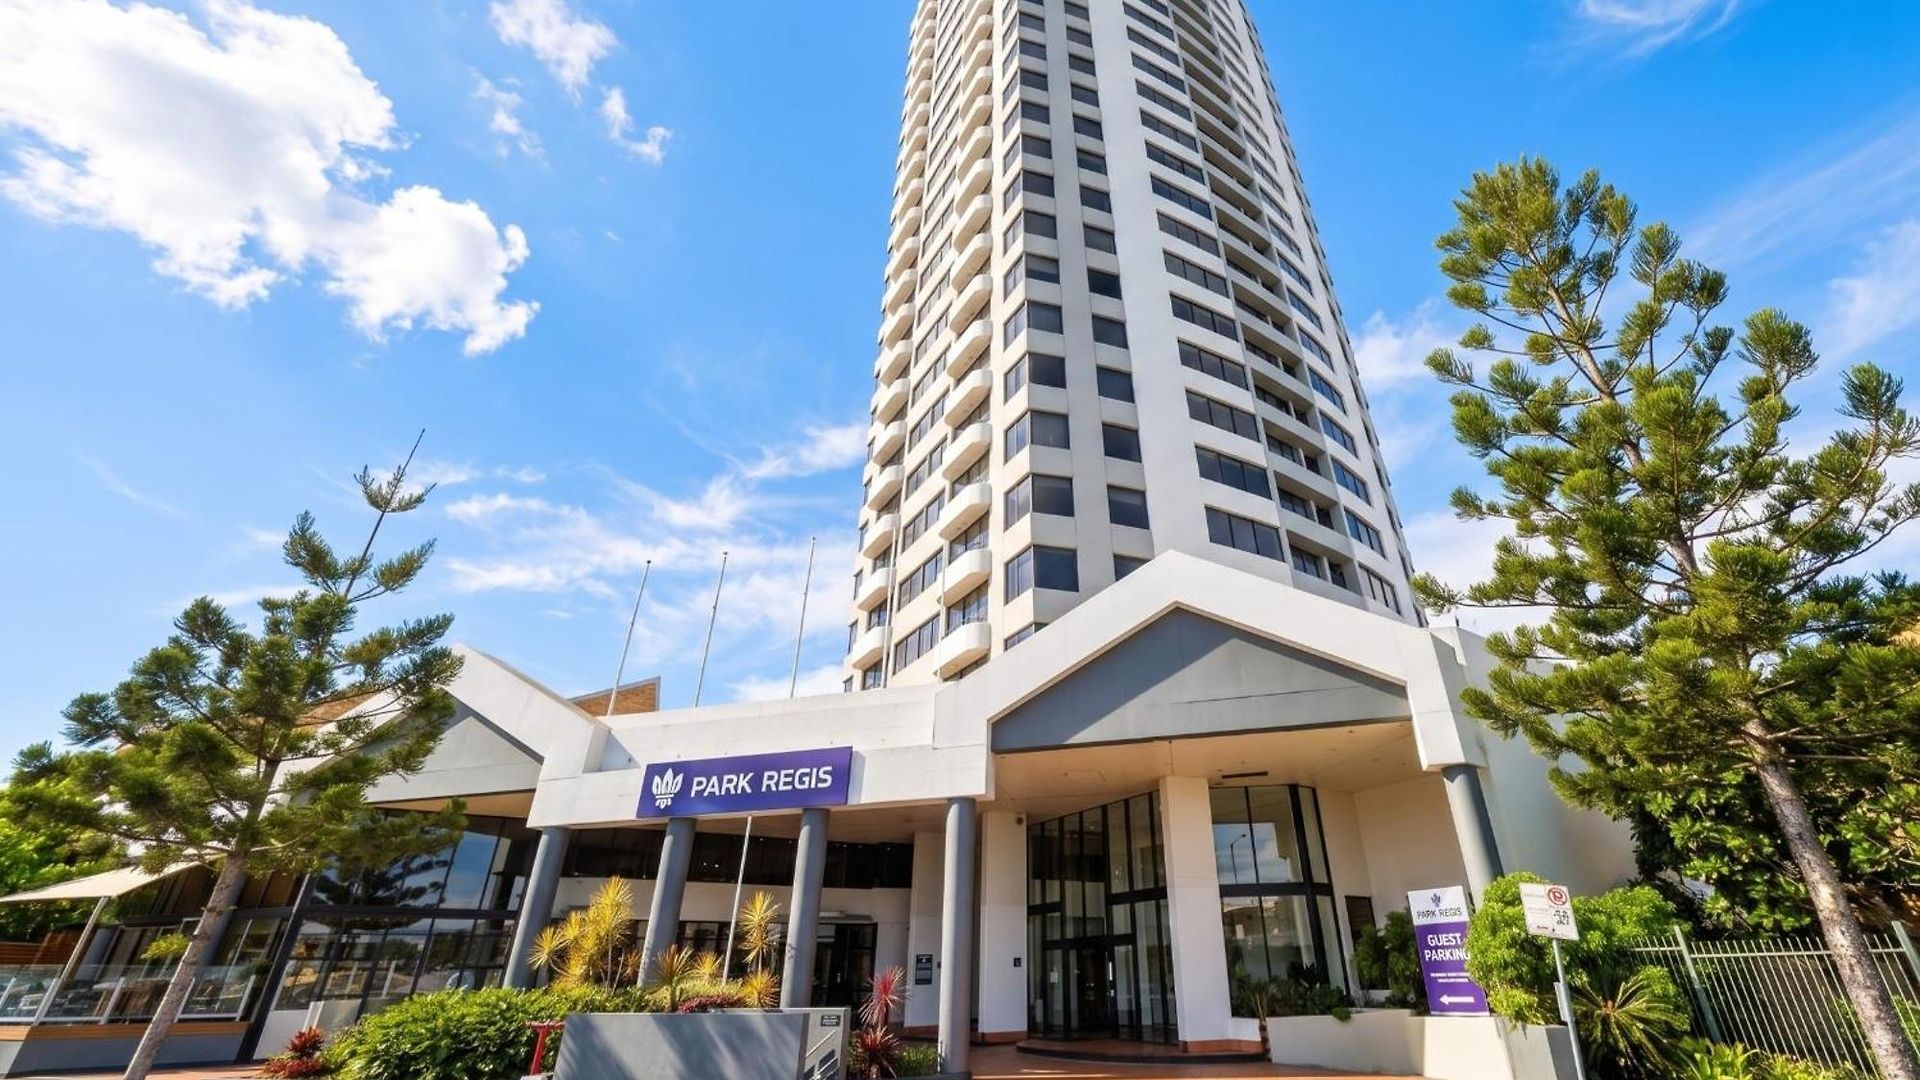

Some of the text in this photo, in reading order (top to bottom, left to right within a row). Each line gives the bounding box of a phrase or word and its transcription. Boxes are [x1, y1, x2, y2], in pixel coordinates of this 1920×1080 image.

[690, 766, 833, 798] PARK REGIS
[1416, 907, 1463, 919] PARK REGIS
[1427, 932, 1462, 947] GUEST
